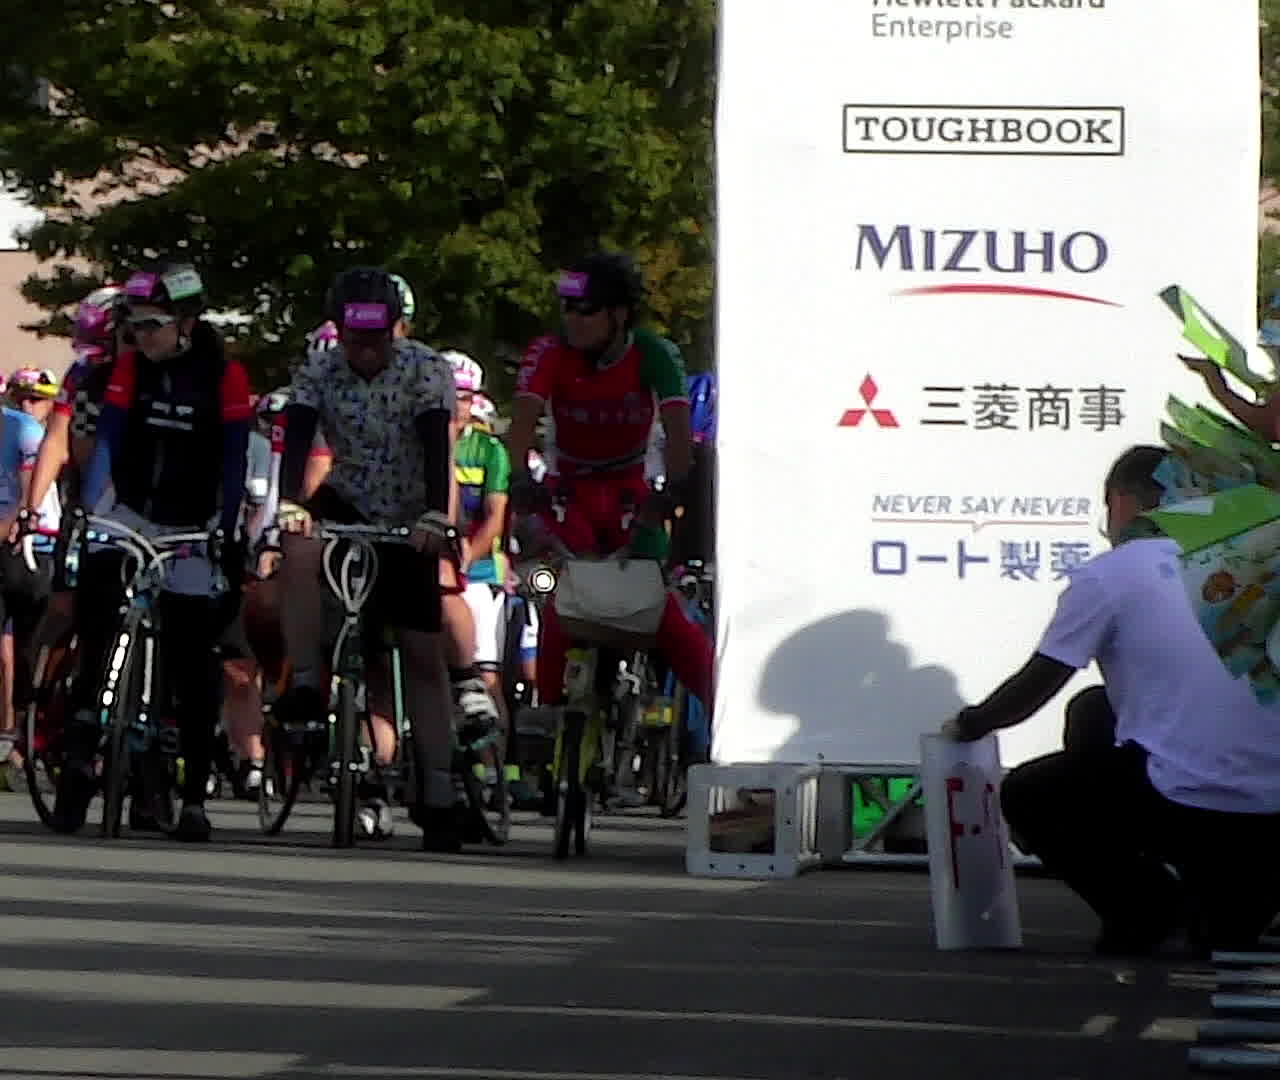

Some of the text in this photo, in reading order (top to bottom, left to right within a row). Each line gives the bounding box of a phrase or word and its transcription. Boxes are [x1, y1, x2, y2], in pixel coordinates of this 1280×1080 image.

[871, 12, 1013, 44] Enterprise
[854, 115, 1114, 145] TOUGHBOOK
[854, 223, 1108, 274] MIZUHO
[919, 381, 1128, 433] 三菱商事
[872, 494, 1092, 516] NEVER SAY NEVER
